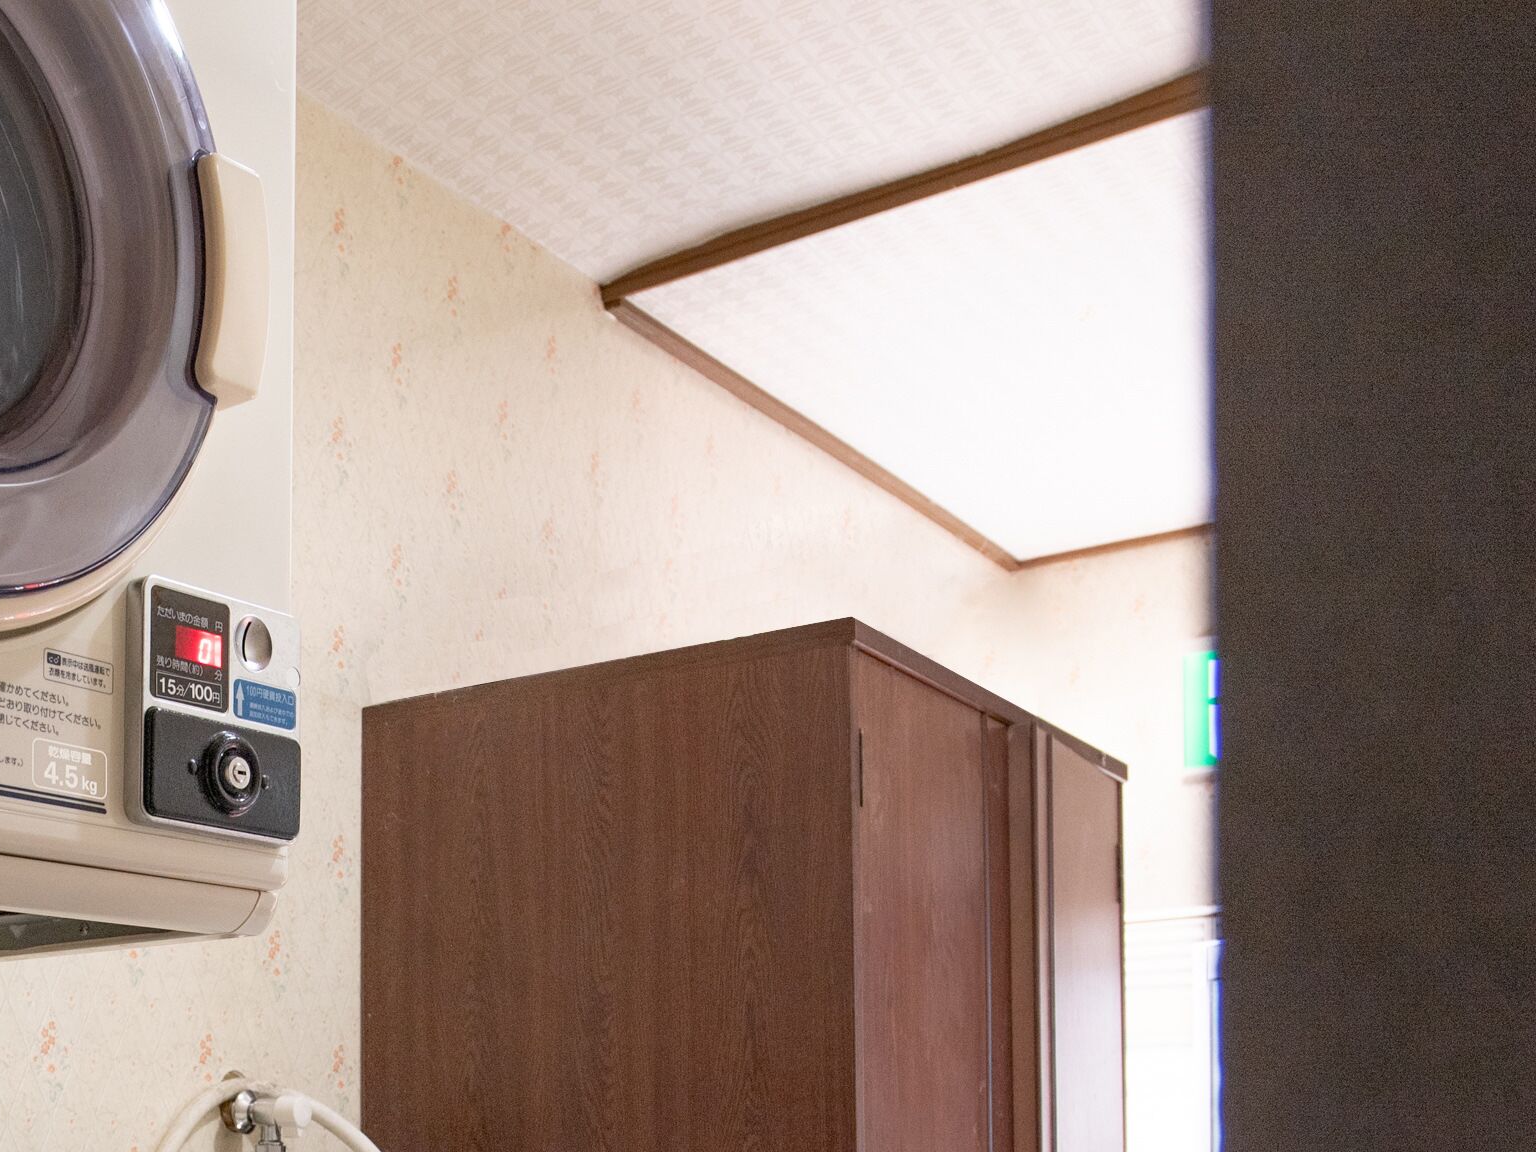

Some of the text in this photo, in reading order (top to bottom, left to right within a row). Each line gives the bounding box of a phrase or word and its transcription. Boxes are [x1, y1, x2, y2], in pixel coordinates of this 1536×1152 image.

[156, 605, 223, 633] ただいまの金額 円
[214, 669, 223, 681] 分
[159, 677, 221, 704] 15分/100円
[48, 745, 92, 766] 乾燥容量
[43, 761, 98, 795] 4.5 kg
